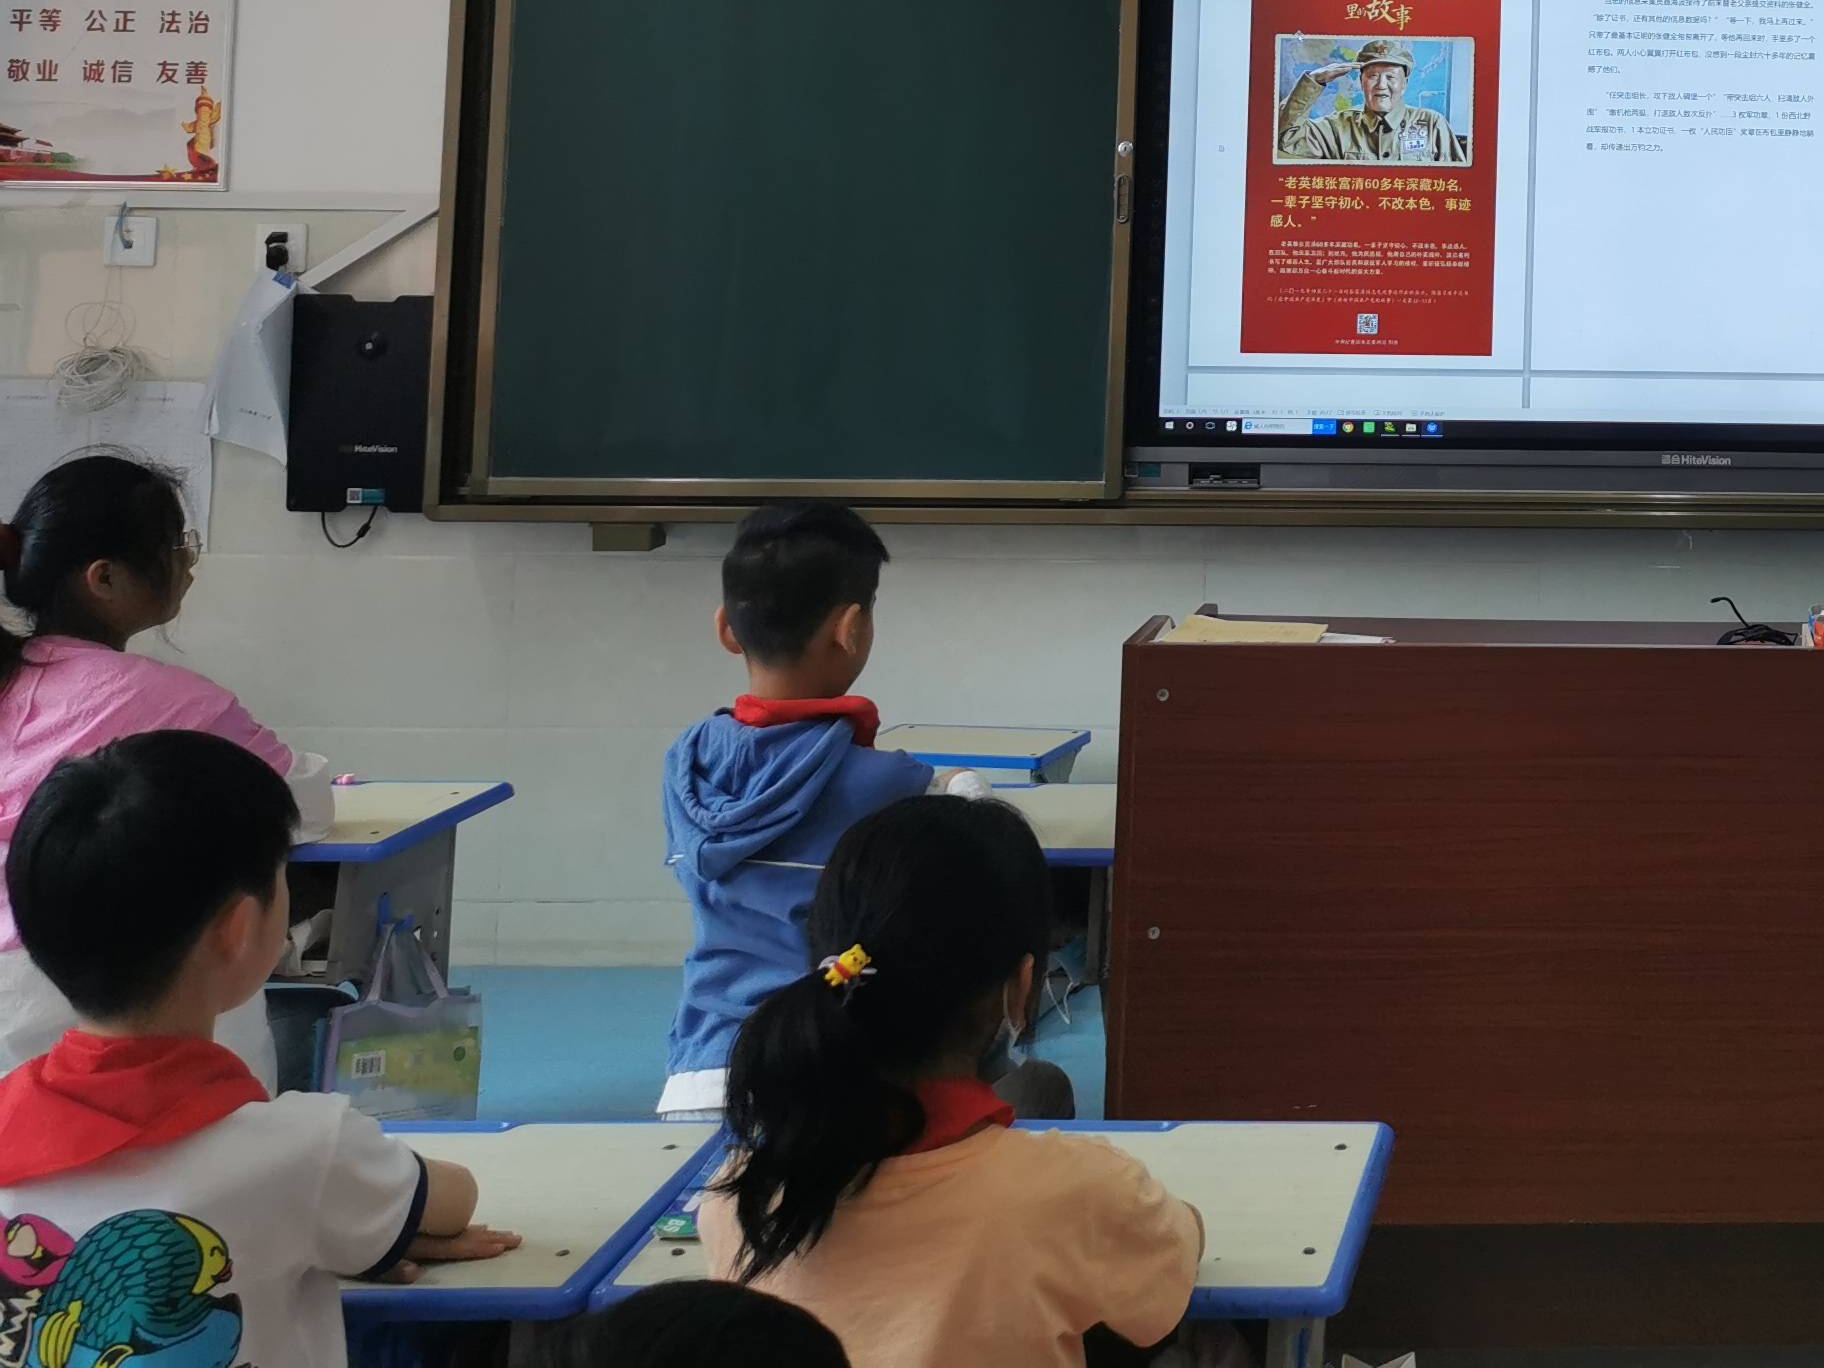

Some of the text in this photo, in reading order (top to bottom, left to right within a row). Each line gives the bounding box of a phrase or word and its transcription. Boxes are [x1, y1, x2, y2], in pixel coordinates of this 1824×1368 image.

[10, 9, 210, 34] 平等 公正 法治
[7, 59, 208, 85] 敬业 诚信 友善
